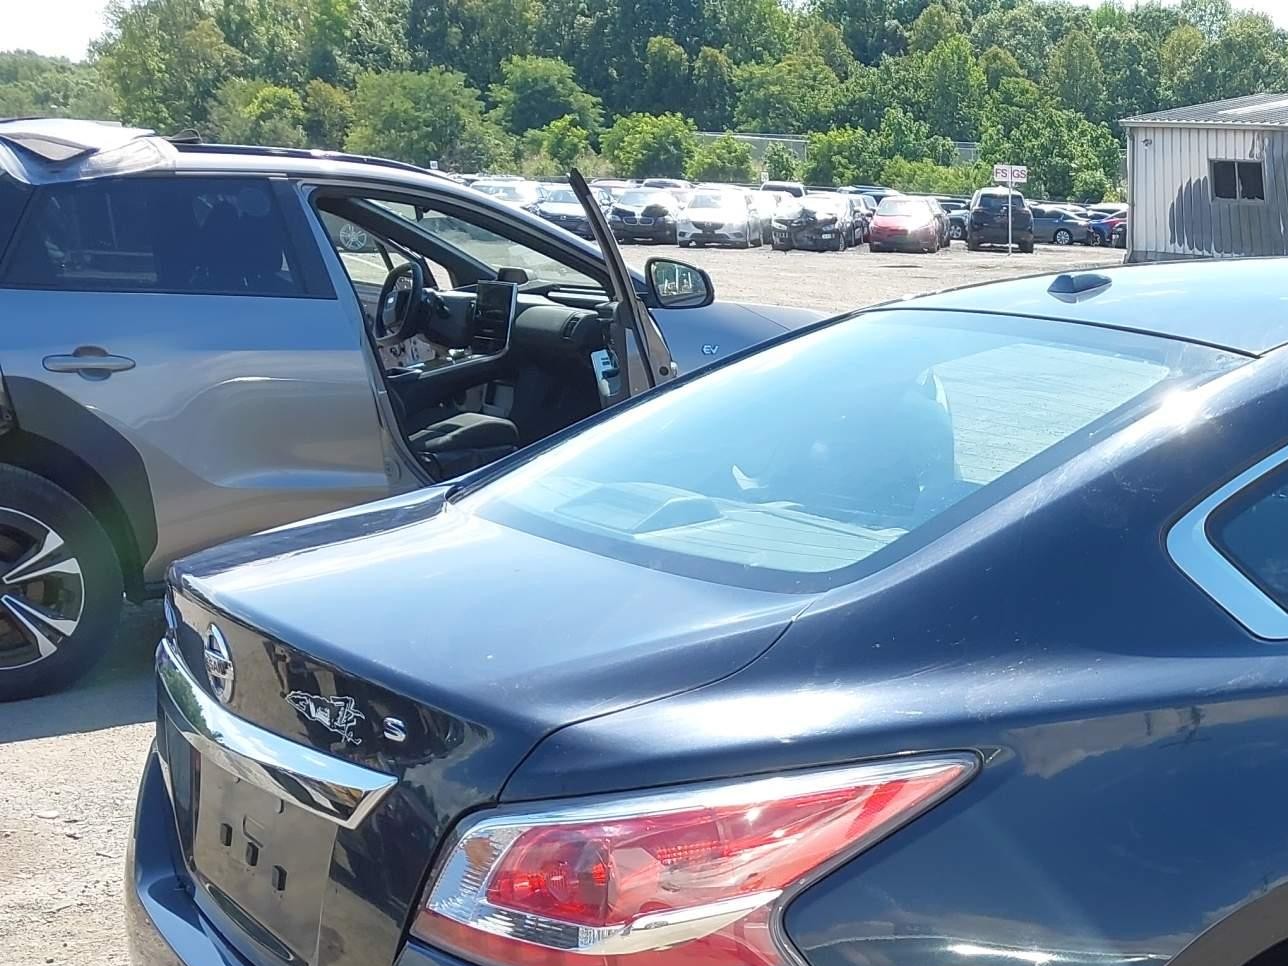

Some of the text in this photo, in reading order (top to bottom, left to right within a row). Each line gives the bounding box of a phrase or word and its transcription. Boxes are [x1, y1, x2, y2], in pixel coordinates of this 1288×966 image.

[995, 168, 1027, 179] FS GS
[702, 345, 719, 354] EV
[383, 716, 407, 743] S
